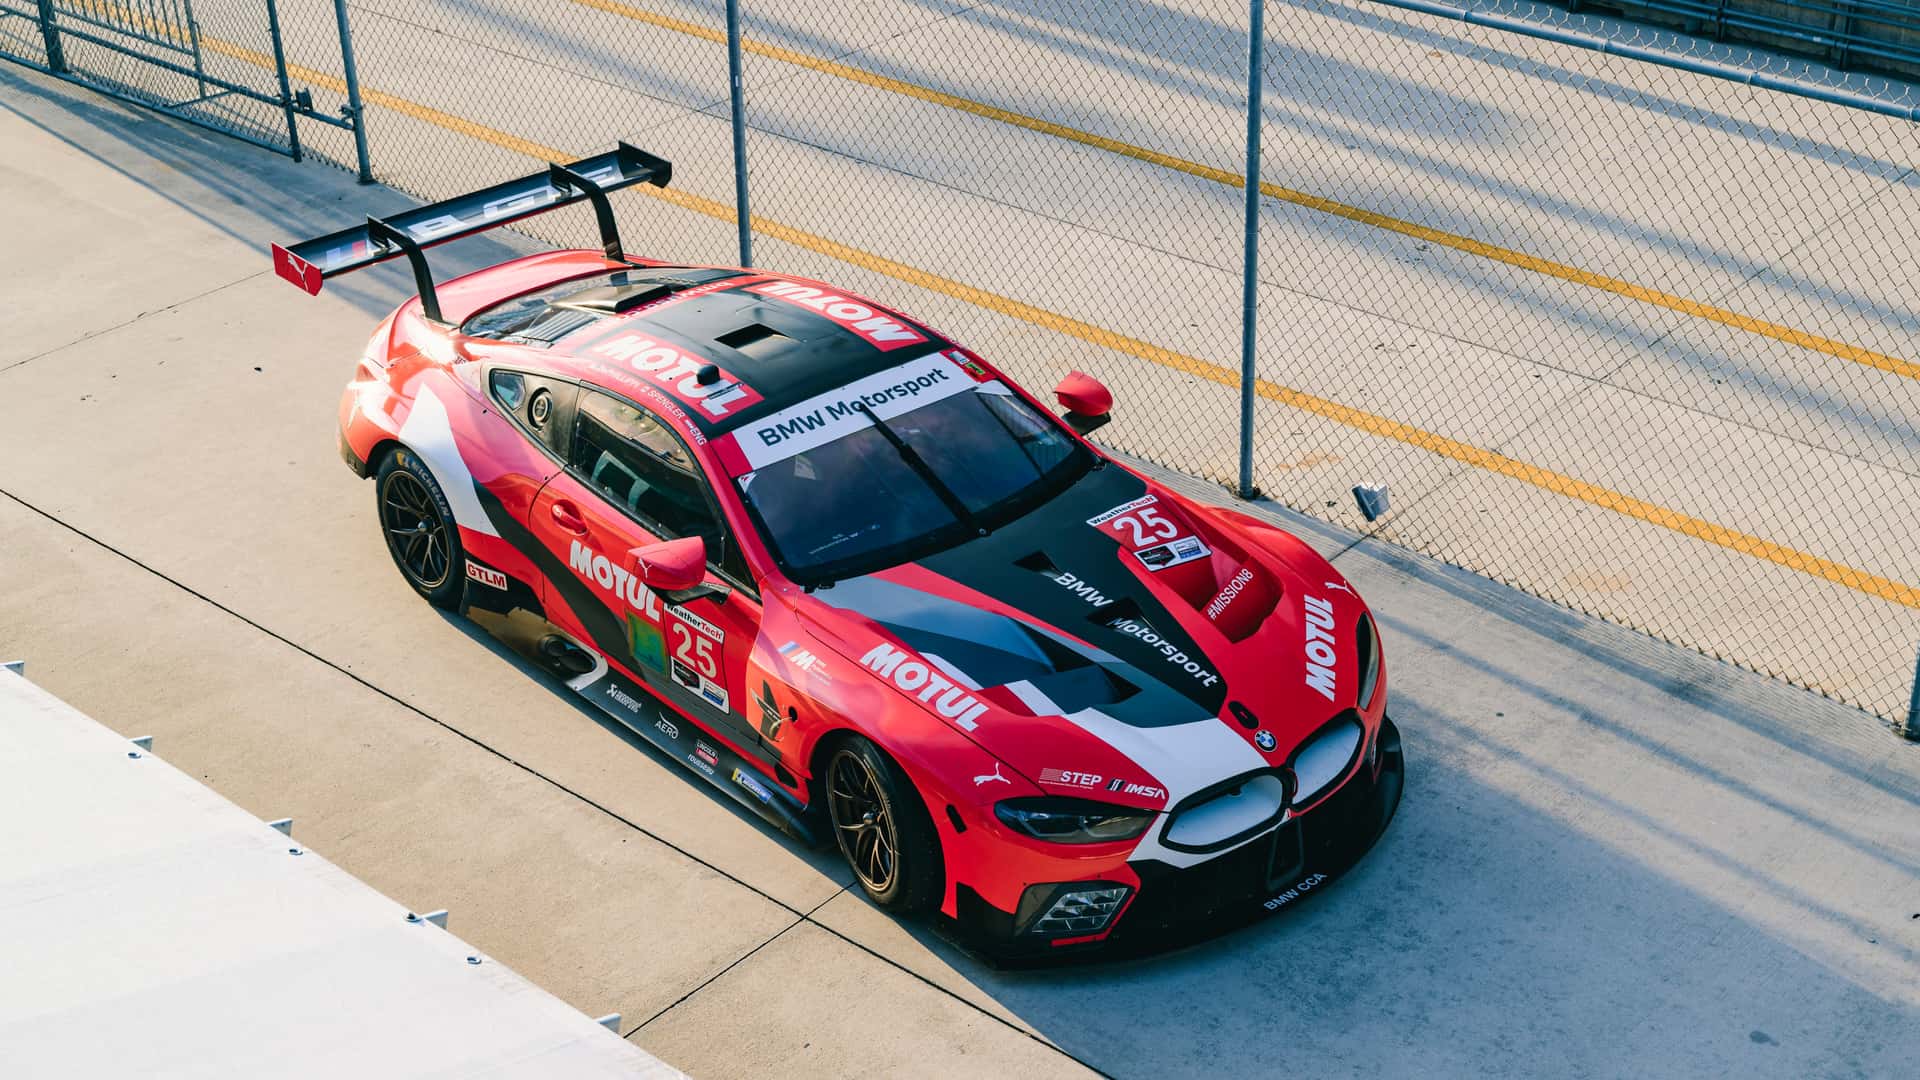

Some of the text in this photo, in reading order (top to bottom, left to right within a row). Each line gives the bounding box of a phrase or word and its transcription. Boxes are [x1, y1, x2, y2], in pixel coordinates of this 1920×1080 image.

[758, 281, 919, 342] MOTUL
[593, 335, 748, 416] MOTUL
[757, 367, 950, 447] BMW Motorsport
[411, 462, 450, 517] MICHELIN
[1090, 494, 1154, 525] WeatherTech
[1113, 507, 1178, 547] 25
[467, 563, 506, 588] GTLM
[569, 539, 662, 622] MOTUL
[1207, 567, 1254, 621] #MISSION8
[672, 622, 717, 679] 25
[1053, 572, 1219, 688] BMW Motorsport
[1303, 594, 1336, 703] MOTUL
[859, 642, 990, 732] MOTUL
[654, 720, 679, 740] AERO
[1060, 770, 1102, 786] STEP
[1124, 783, 1166, 800] IMSA
[1263, 871, 1327, 912] BMW CCA
